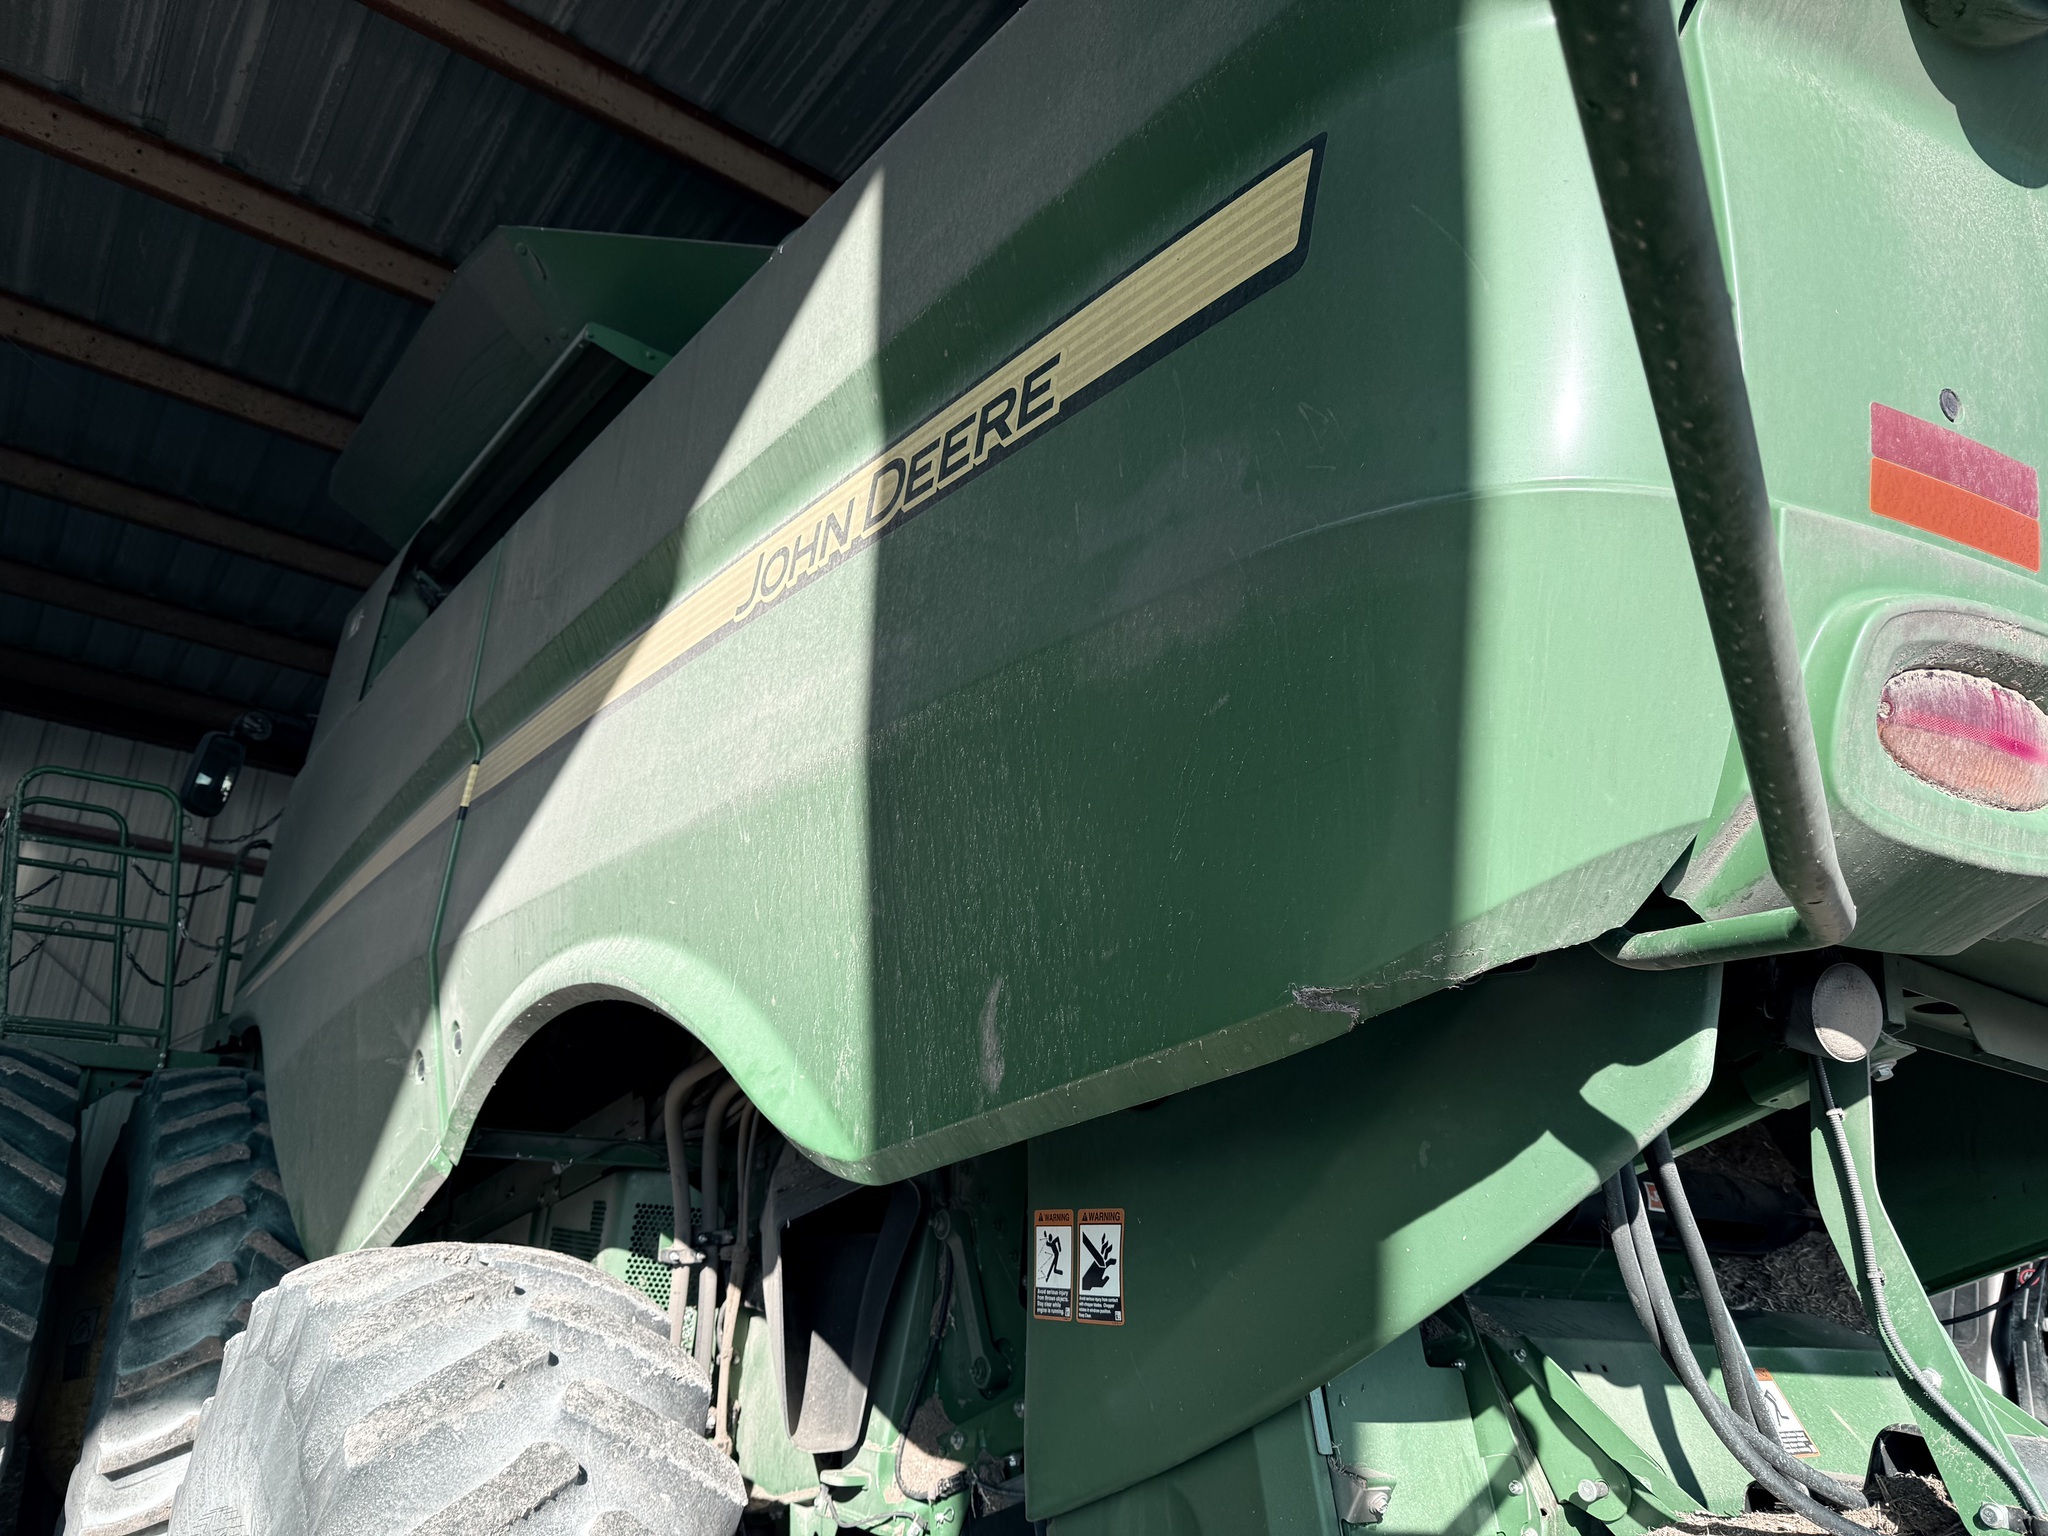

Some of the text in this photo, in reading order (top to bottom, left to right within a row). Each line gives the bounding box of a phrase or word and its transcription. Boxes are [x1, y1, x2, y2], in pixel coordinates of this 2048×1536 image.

[734, 351, 1063, 617] JOHN DEERE
[1044, 1212, 1070, 1222] WARNING
[1088, 1211, 1121, 1222] WARNING
